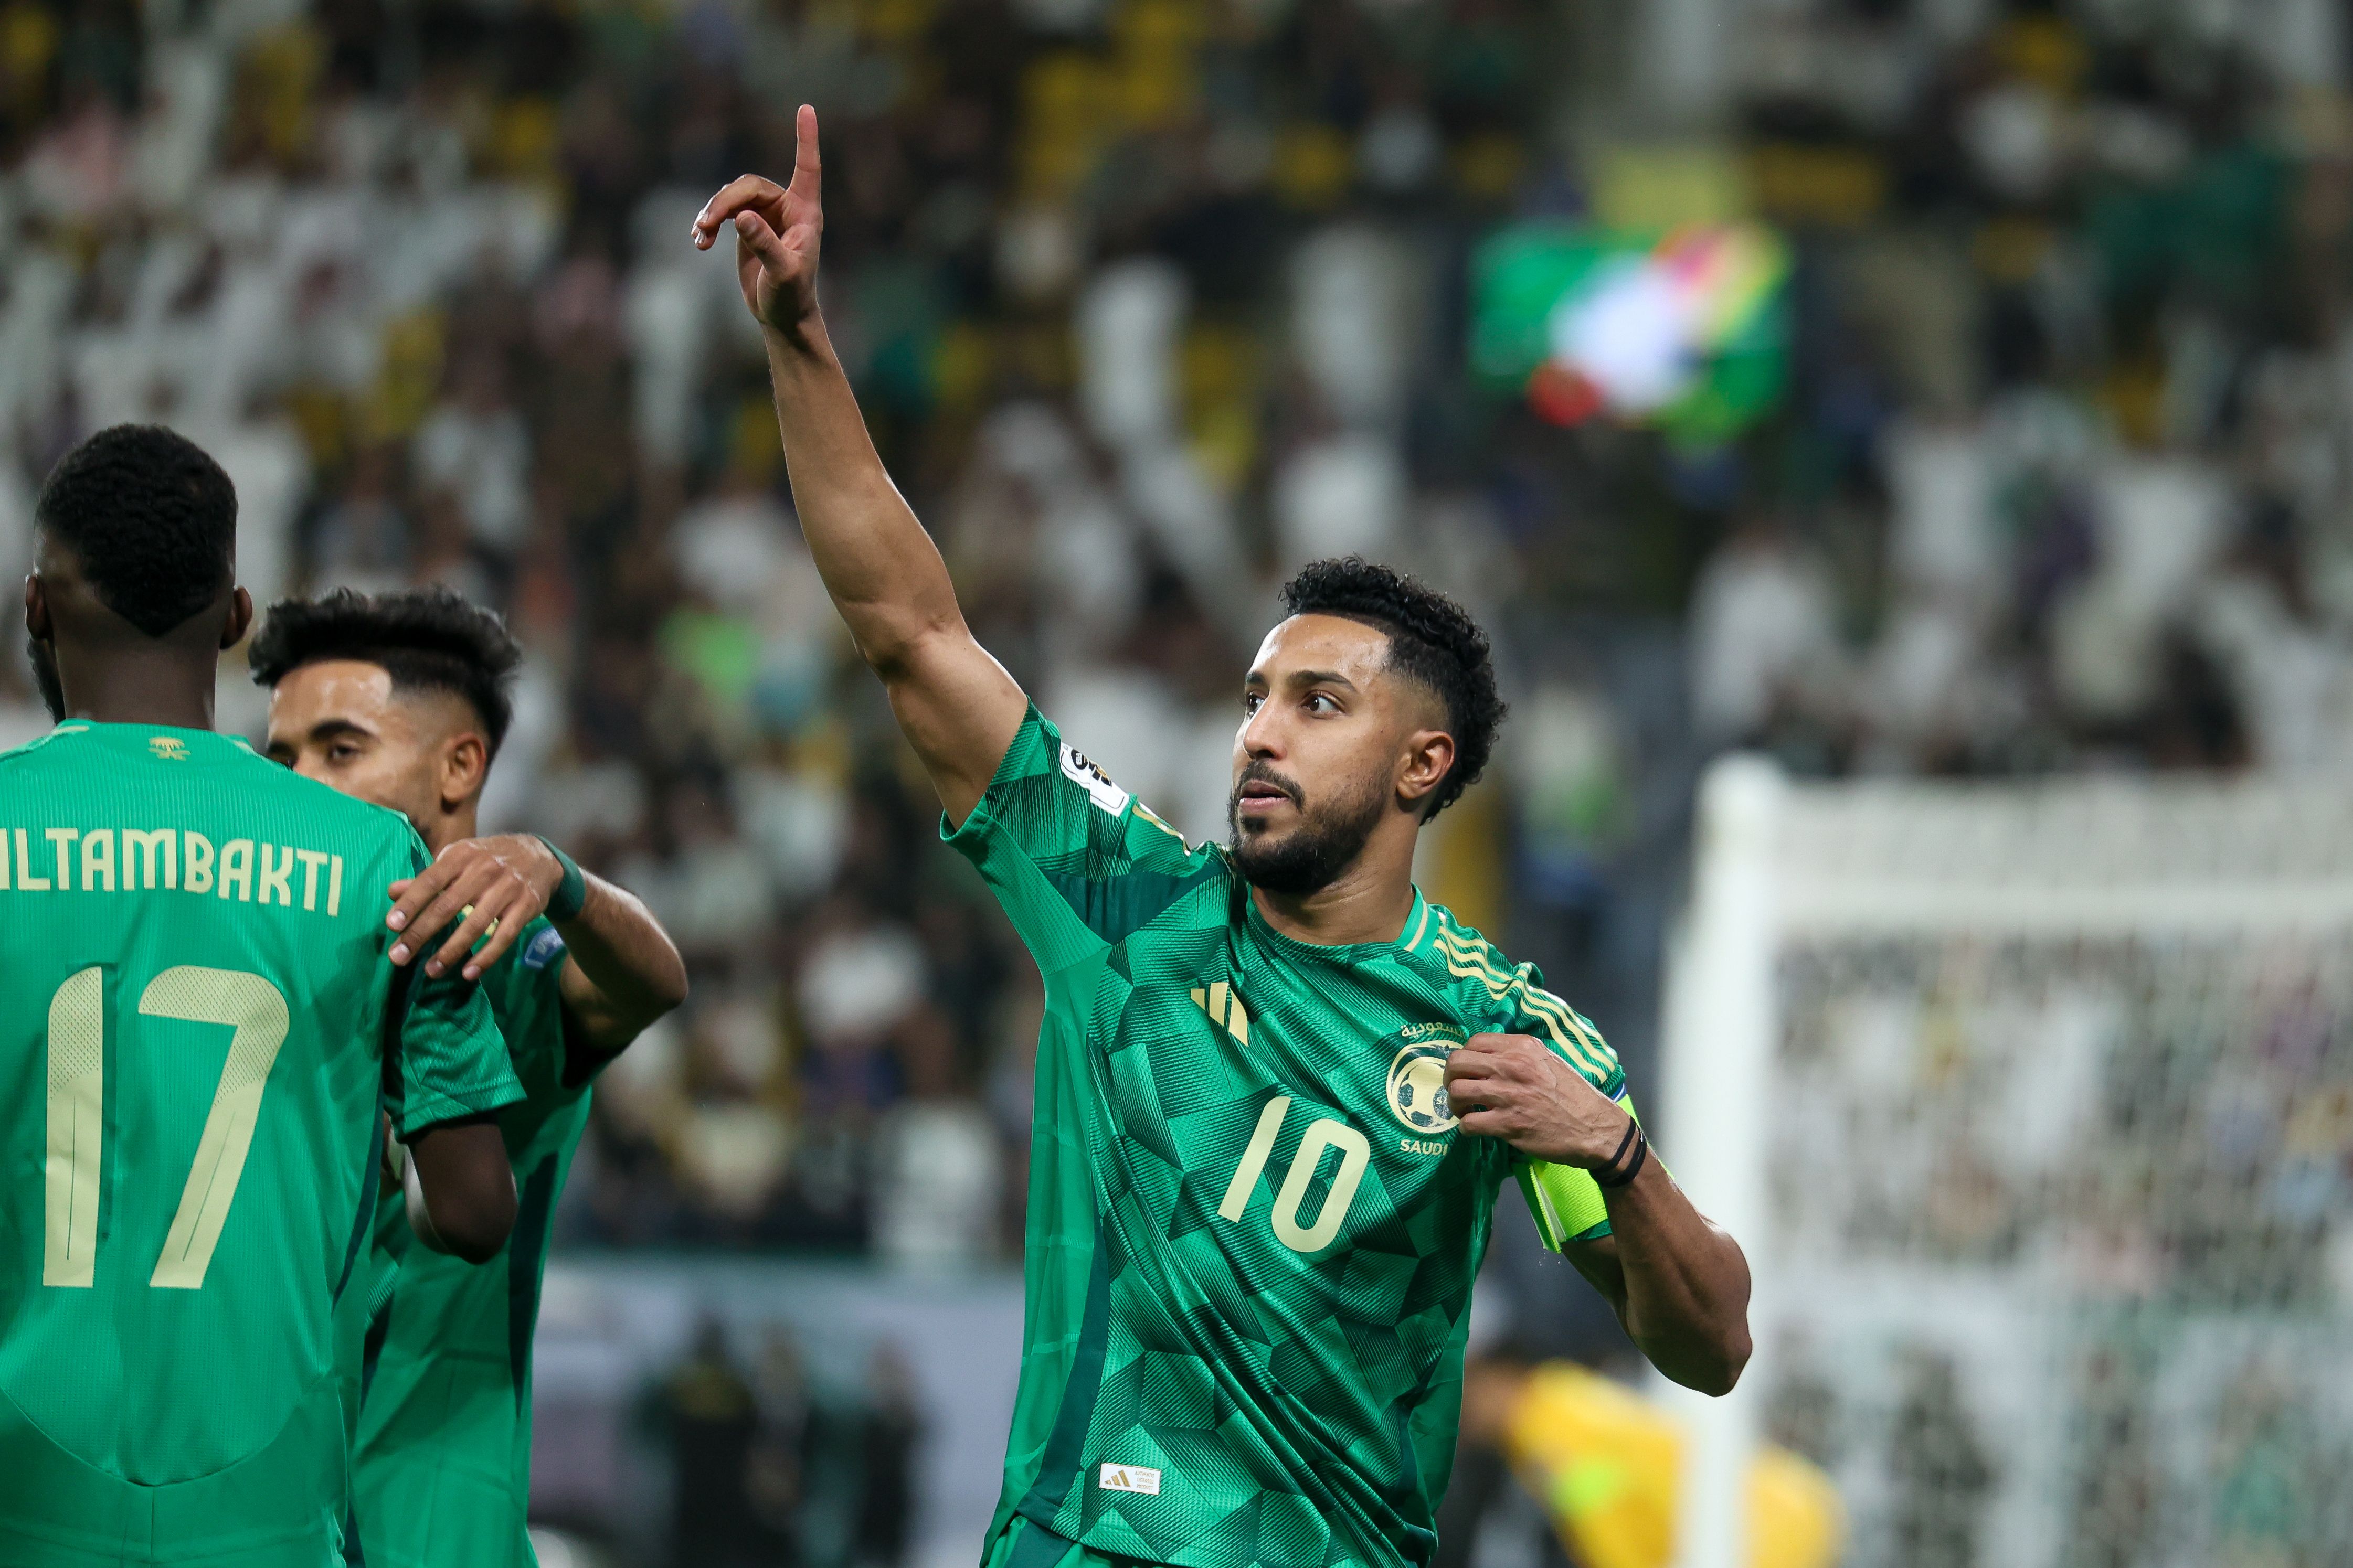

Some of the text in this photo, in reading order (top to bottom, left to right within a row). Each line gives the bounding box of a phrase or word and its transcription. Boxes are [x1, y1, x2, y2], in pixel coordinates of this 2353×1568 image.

[43, 964, 290, 1289] 17
[1217, 1096, 1371, 1253] 10
[1399, 1139, 1448, 1156] SAUDI
